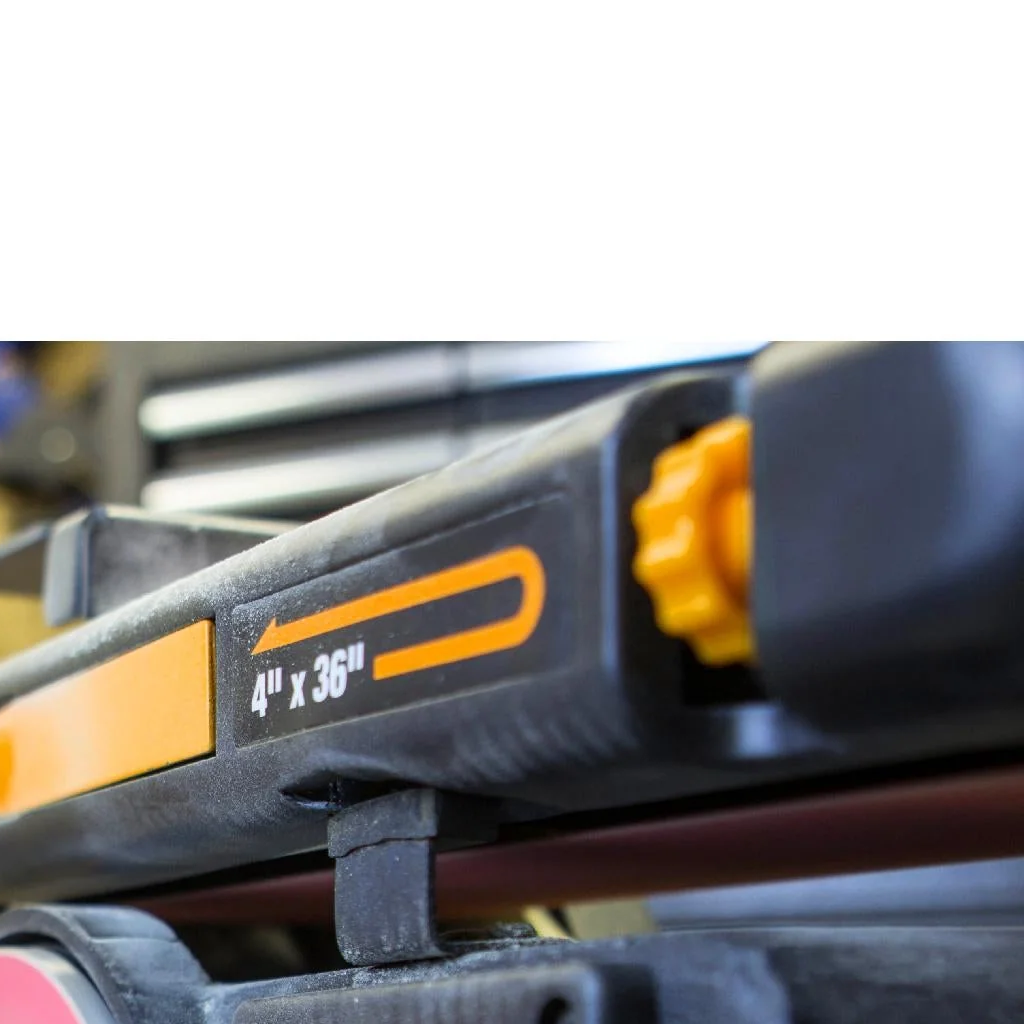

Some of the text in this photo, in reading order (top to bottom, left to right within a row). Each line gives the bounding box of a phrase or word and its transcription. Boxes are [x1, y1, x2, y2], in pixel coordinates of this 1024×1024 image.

[251, 641, 365, 717] 4" x 36"
